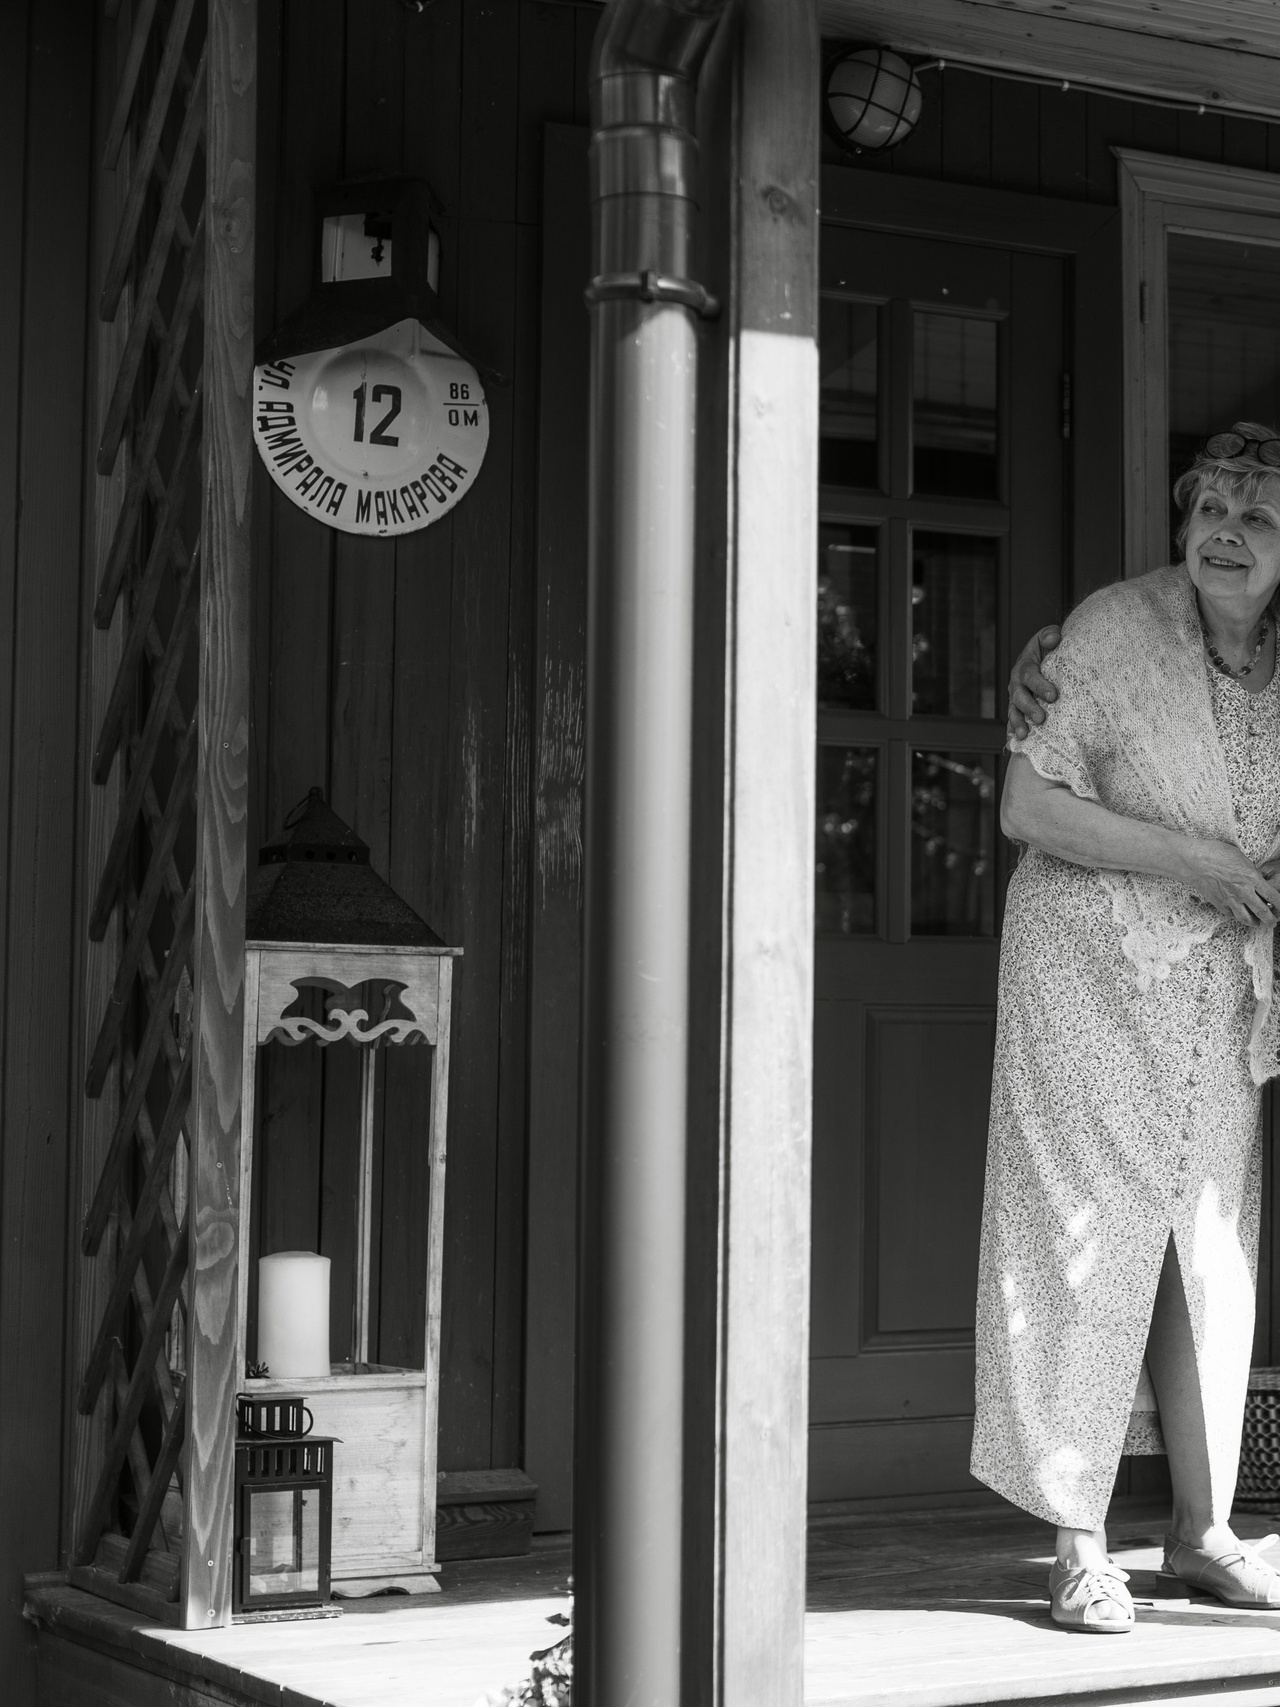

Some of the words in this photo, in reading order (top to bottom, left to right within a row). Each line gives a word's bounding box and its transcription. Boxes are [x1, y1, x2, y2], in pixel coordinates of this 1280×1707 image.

[353, 382, 402, 447] 12
[450, 382, 470, 400] 86
[257, 401, 348, 516] АДМИРАЛА
[355, 453, 468, 526] МАКАРОВА
